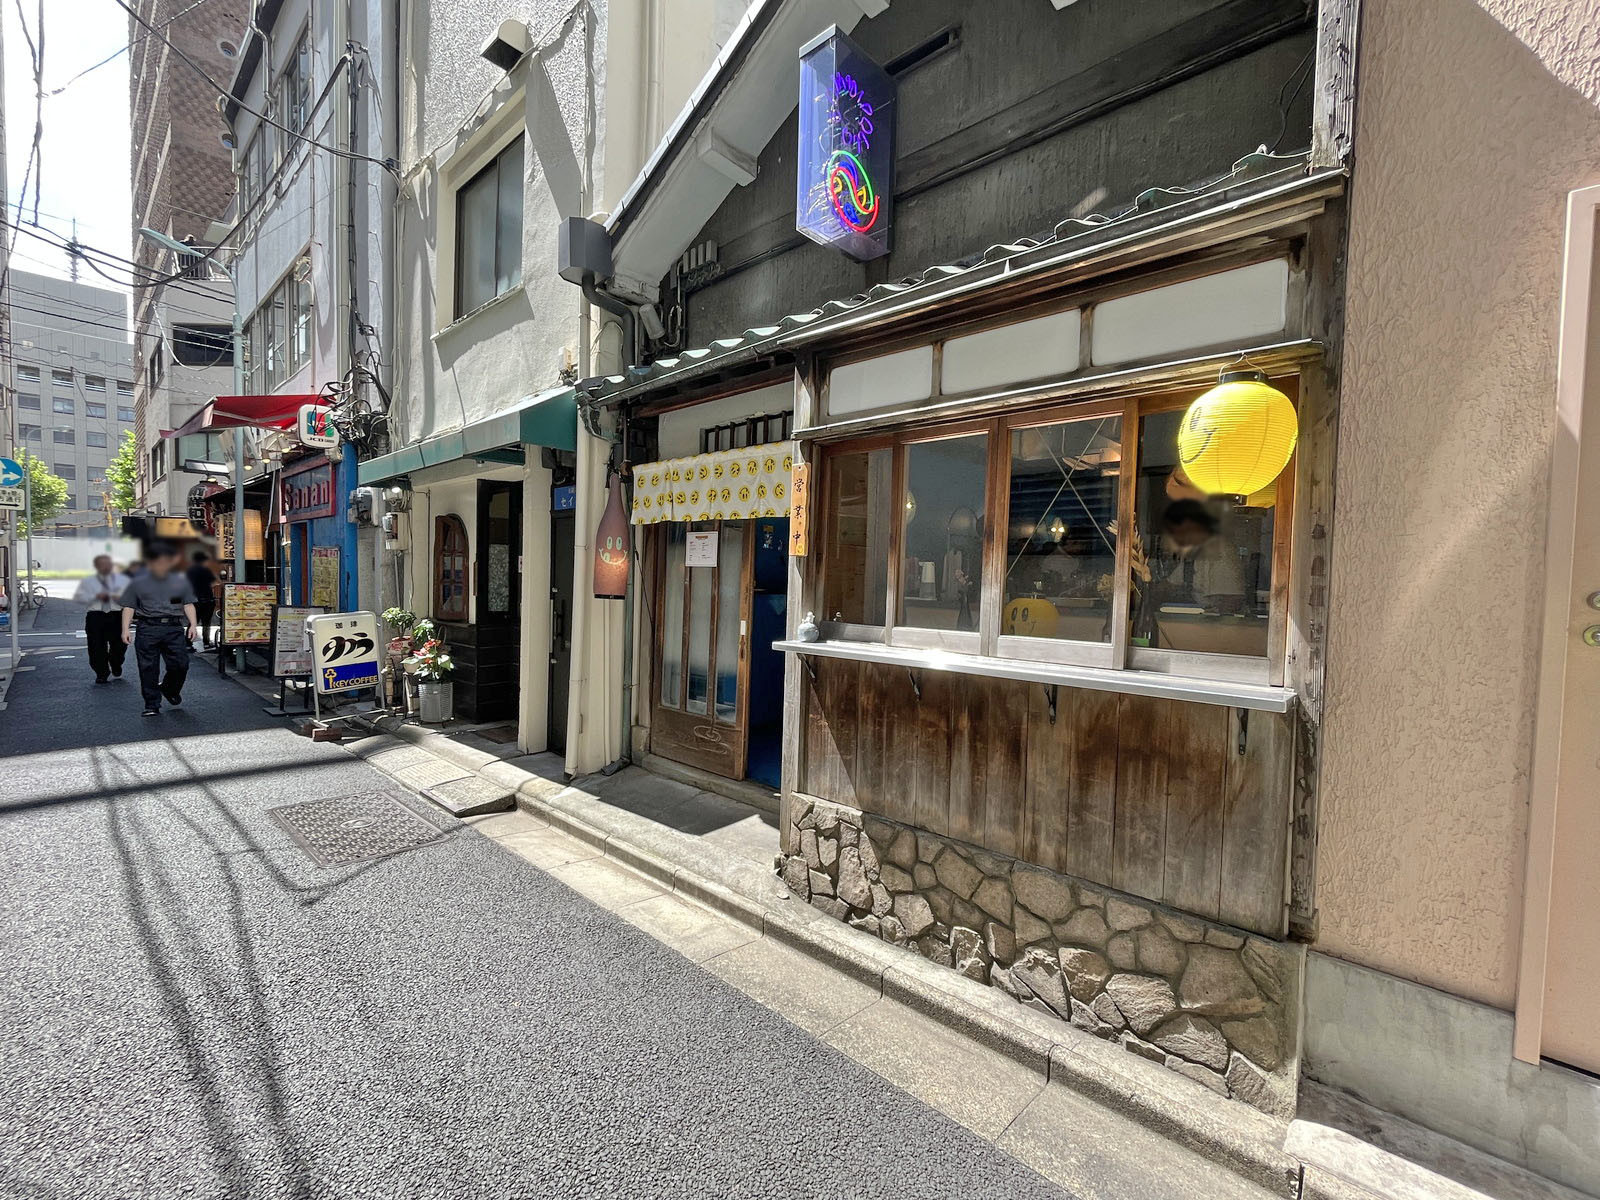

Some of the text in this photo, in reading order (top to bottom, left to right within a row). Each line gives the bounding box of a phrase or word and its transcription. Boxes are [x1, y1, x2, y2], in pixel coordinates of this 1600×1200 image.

[285, 480, 330, 511] Sanan
[793, 478, 805, 545] 営業中
[333, 675, 378, 688] KEY COFFEE
